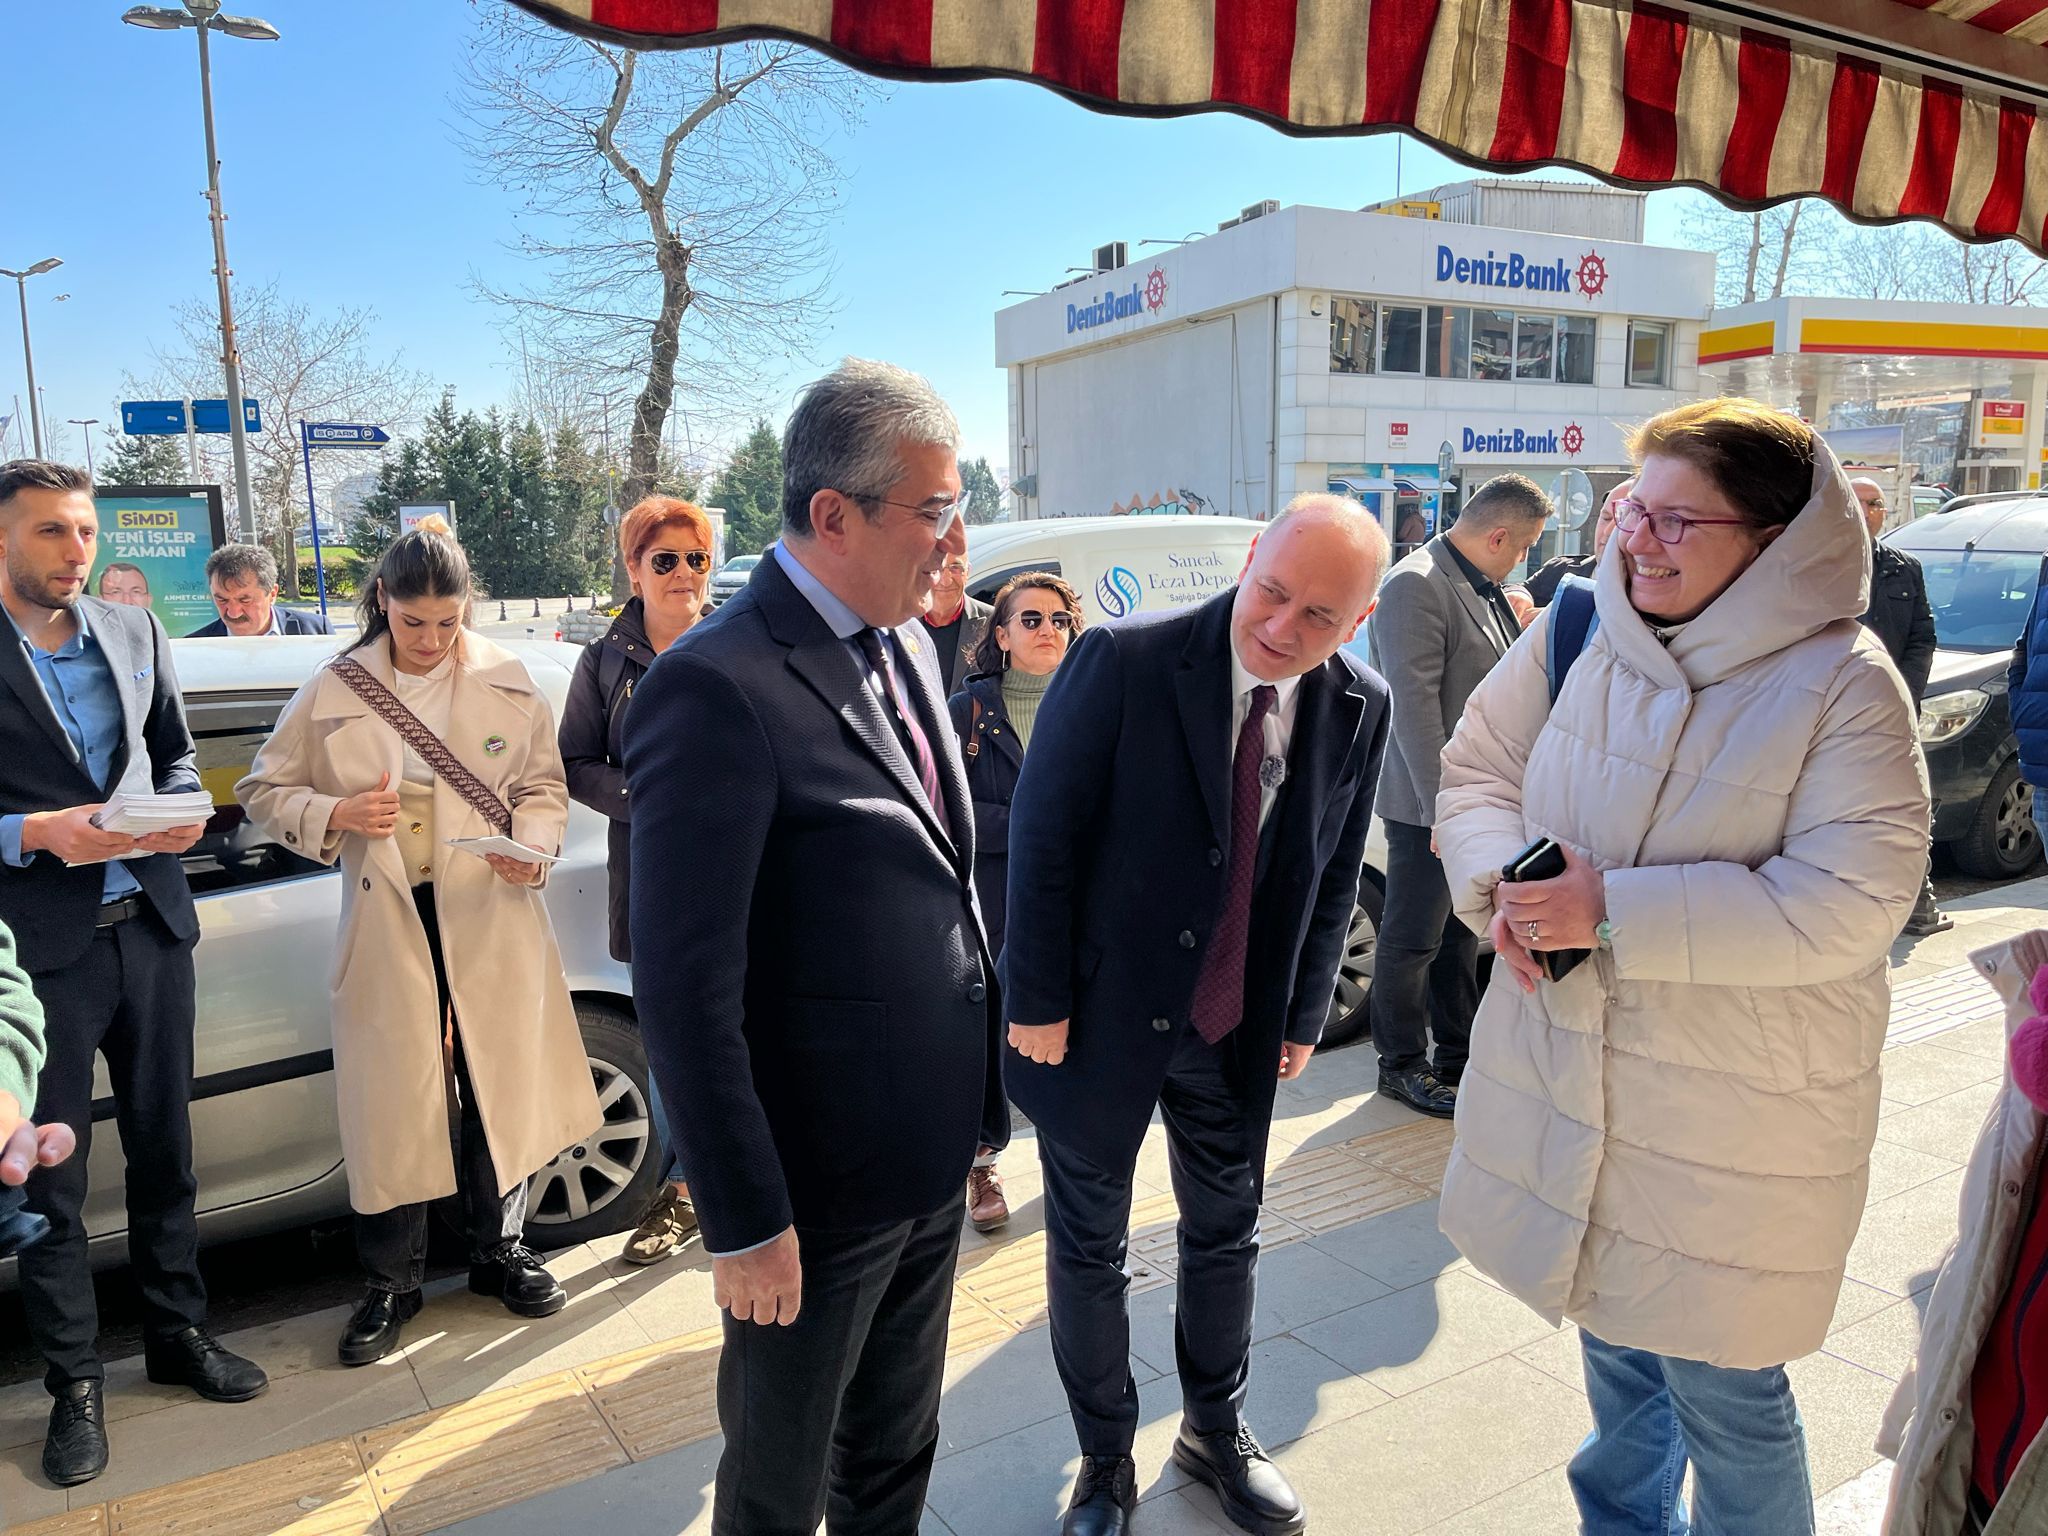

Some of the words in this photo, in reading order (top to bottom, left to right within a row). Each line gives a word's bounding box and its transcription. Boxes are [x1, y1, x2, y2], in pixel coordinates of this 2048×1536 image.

[1436, 244, 1571, 293] DenizBank
[1066, 282, 1144, 334] DenizBank
[1462, 426, 1558, 453] DenizBank
[103, 530, 144, 543] YENİ
[148, 530, 196, 545] İŞLER
[115, 546, 186, 557] ZAMANI
[1168, 551, 1224, 568] Sancak
[1148, 573, 1186, 589] Ecza
